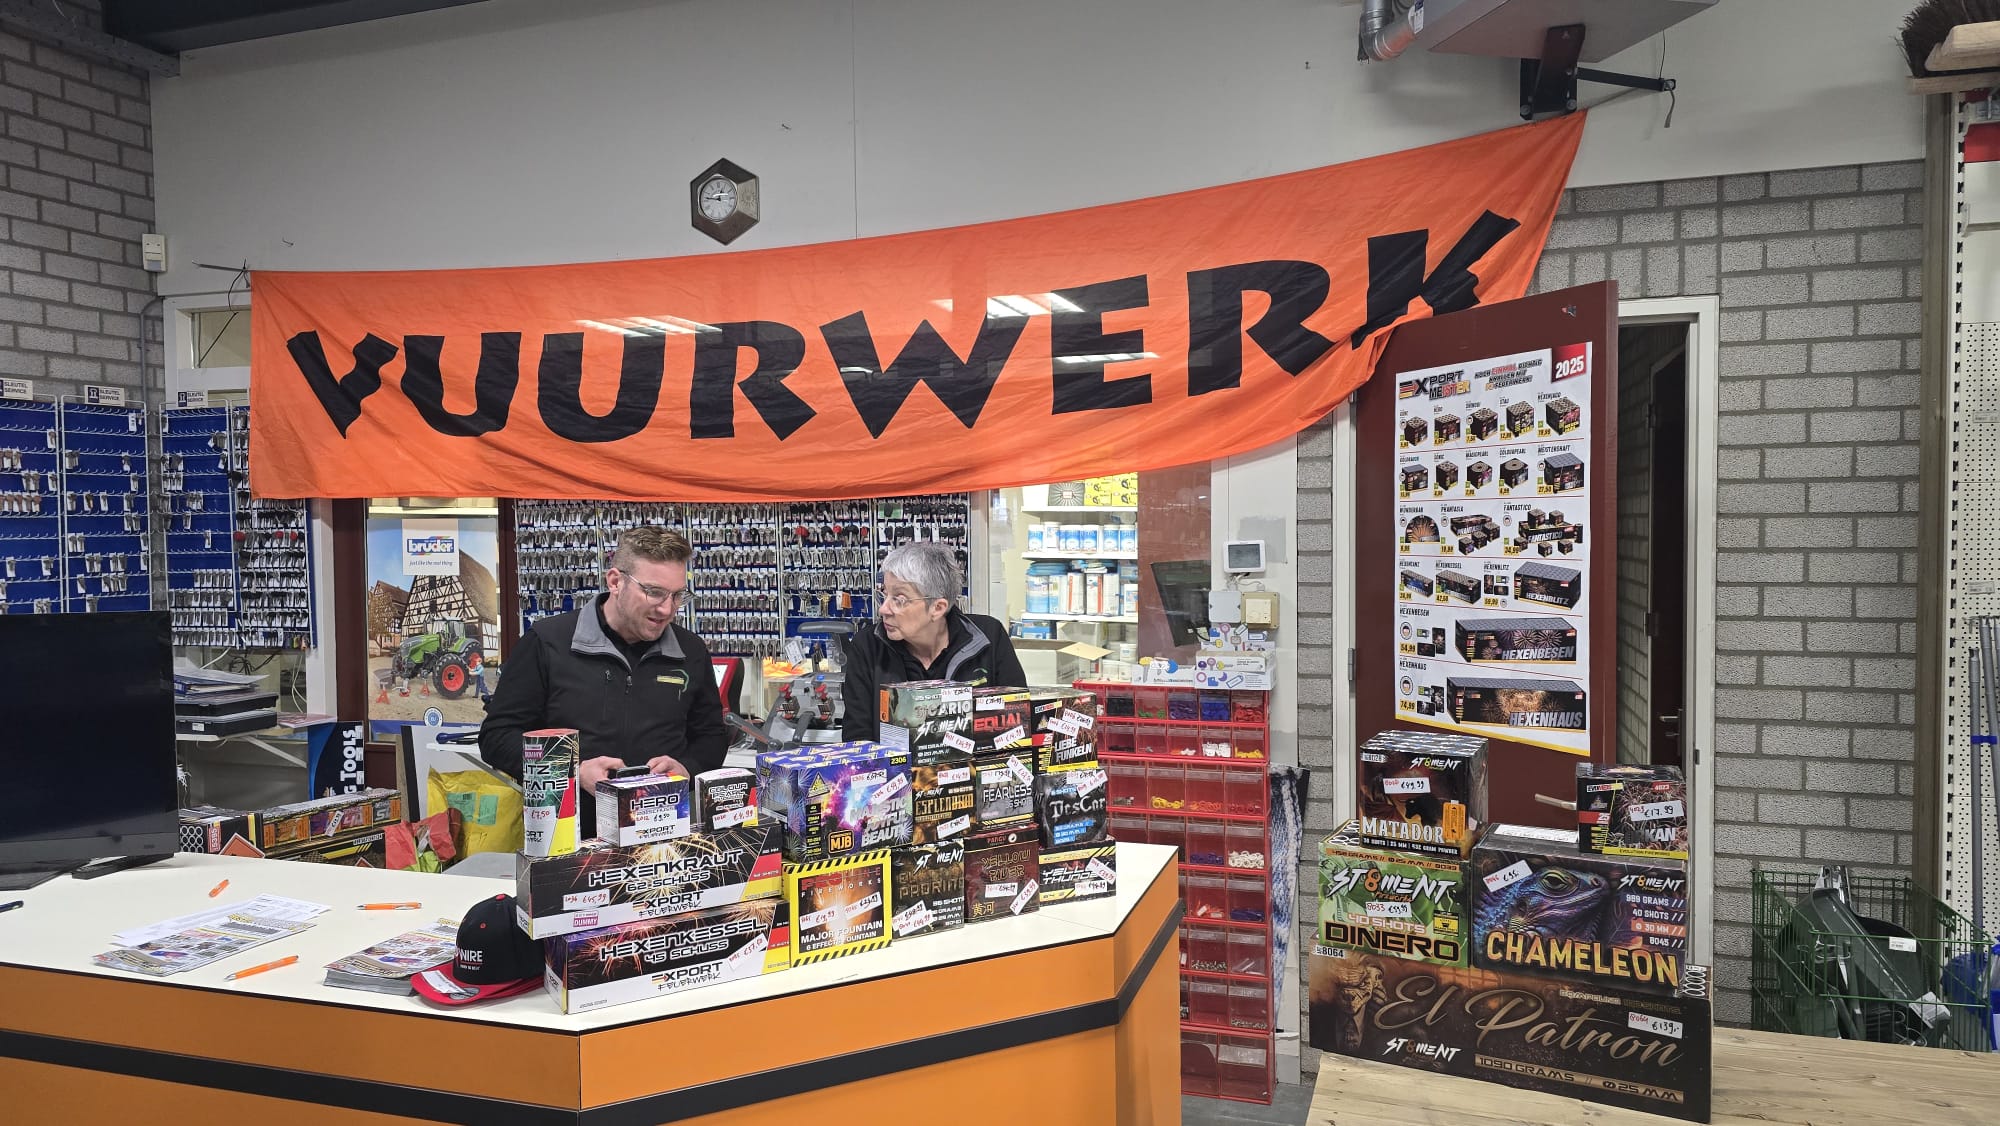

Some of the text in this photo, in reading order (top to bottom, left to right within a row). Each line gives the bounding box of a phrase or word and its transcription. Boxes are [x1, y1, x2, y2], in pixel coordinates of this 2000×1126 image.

[287, 210, 1520, 442] VUURWERK
[1556, 355, 1585, 378] 2025
[1429, 381, 1471, 400] MEISTER
[409, 539, 453, 552] bruder
[1526, 592, 1569, 605] HEXENBLITZ
[1502, 646, 1574, 660] HEXENBESEN
[1509, 711, 1583, 728] HEXENHAUS
[1054, 738, 1077, 751] LIEBE
[1056, 743, 1092, 762] FUNKELN
[1409, 758, 1461, 770] ST8MENT
[709, 783, 748, 794] COLOUR
[983, 784, 1032, 802] FEARLESS
[631, 795, 679, 809] HERO
[1362, 816, 1445, 844] MATADOR
[831, 836, 852, 850] MJB
[1438, 847, 1458, 855] POWDER
[981, 849, 1031, 868] YELLOW
[1348, 852, 1378, 860] GRAMS
[589, 850, 743, 886] HEXENKRAUT
[989, 865, 1024, 881] RIVER
[627, 871, 710, 892] 62 SCHUSS
[1043, 872, 1099, 885] THUNDE
[1326, 866, 1457, 904] ST8MENT
[1617, 874, 1685, 892] ST8MENT
[633, 891, 704, 911] EXPORT
[640, 900, 701, 918] FEUERWERK
[972, 901, 994, 917] 黄河
[1366, 902, 1386, 912] 8033
[1642, 896, 1669, 906] GRAMS
[574, 917, 598, 926] DUMMY
[1348, 913, 1370, 926] 40
[1371, 915, 1426, 933] SHOTS
[1633, 909, 1669, 920] 40 SHOTS
[801, 920, 883, 944] MAJOR FOUNTAIN
[1645, 923, 1655, 931] 30
[1657, 924, 1669, 933] MM
[602, 919, 768, 961] HEXENKESSEL
[1325, 921, 1460, 962] DINERO
[645, 952, 666, 963] 45
[671, 940, 729, 959] SCHUSS
[1322, 947, 1344, 958] 8064
[1487, 929, 1680, 988] CHAMELEON
[652, 962, 723, 985] EXPORT
[658, 975, 720, 991] FEUERWERK
[1374, 975, 1685, 1067] El Patron
[1383, 1037, 1462, 1062] ST8MENT
[1480, 1057, 1512, 1070] 1090
[1515, 1064, 1575, 1083] GRAMS
[1618, 1084, 1640, 1094] 25
[1643, 1087, 1679, 1102] MM
